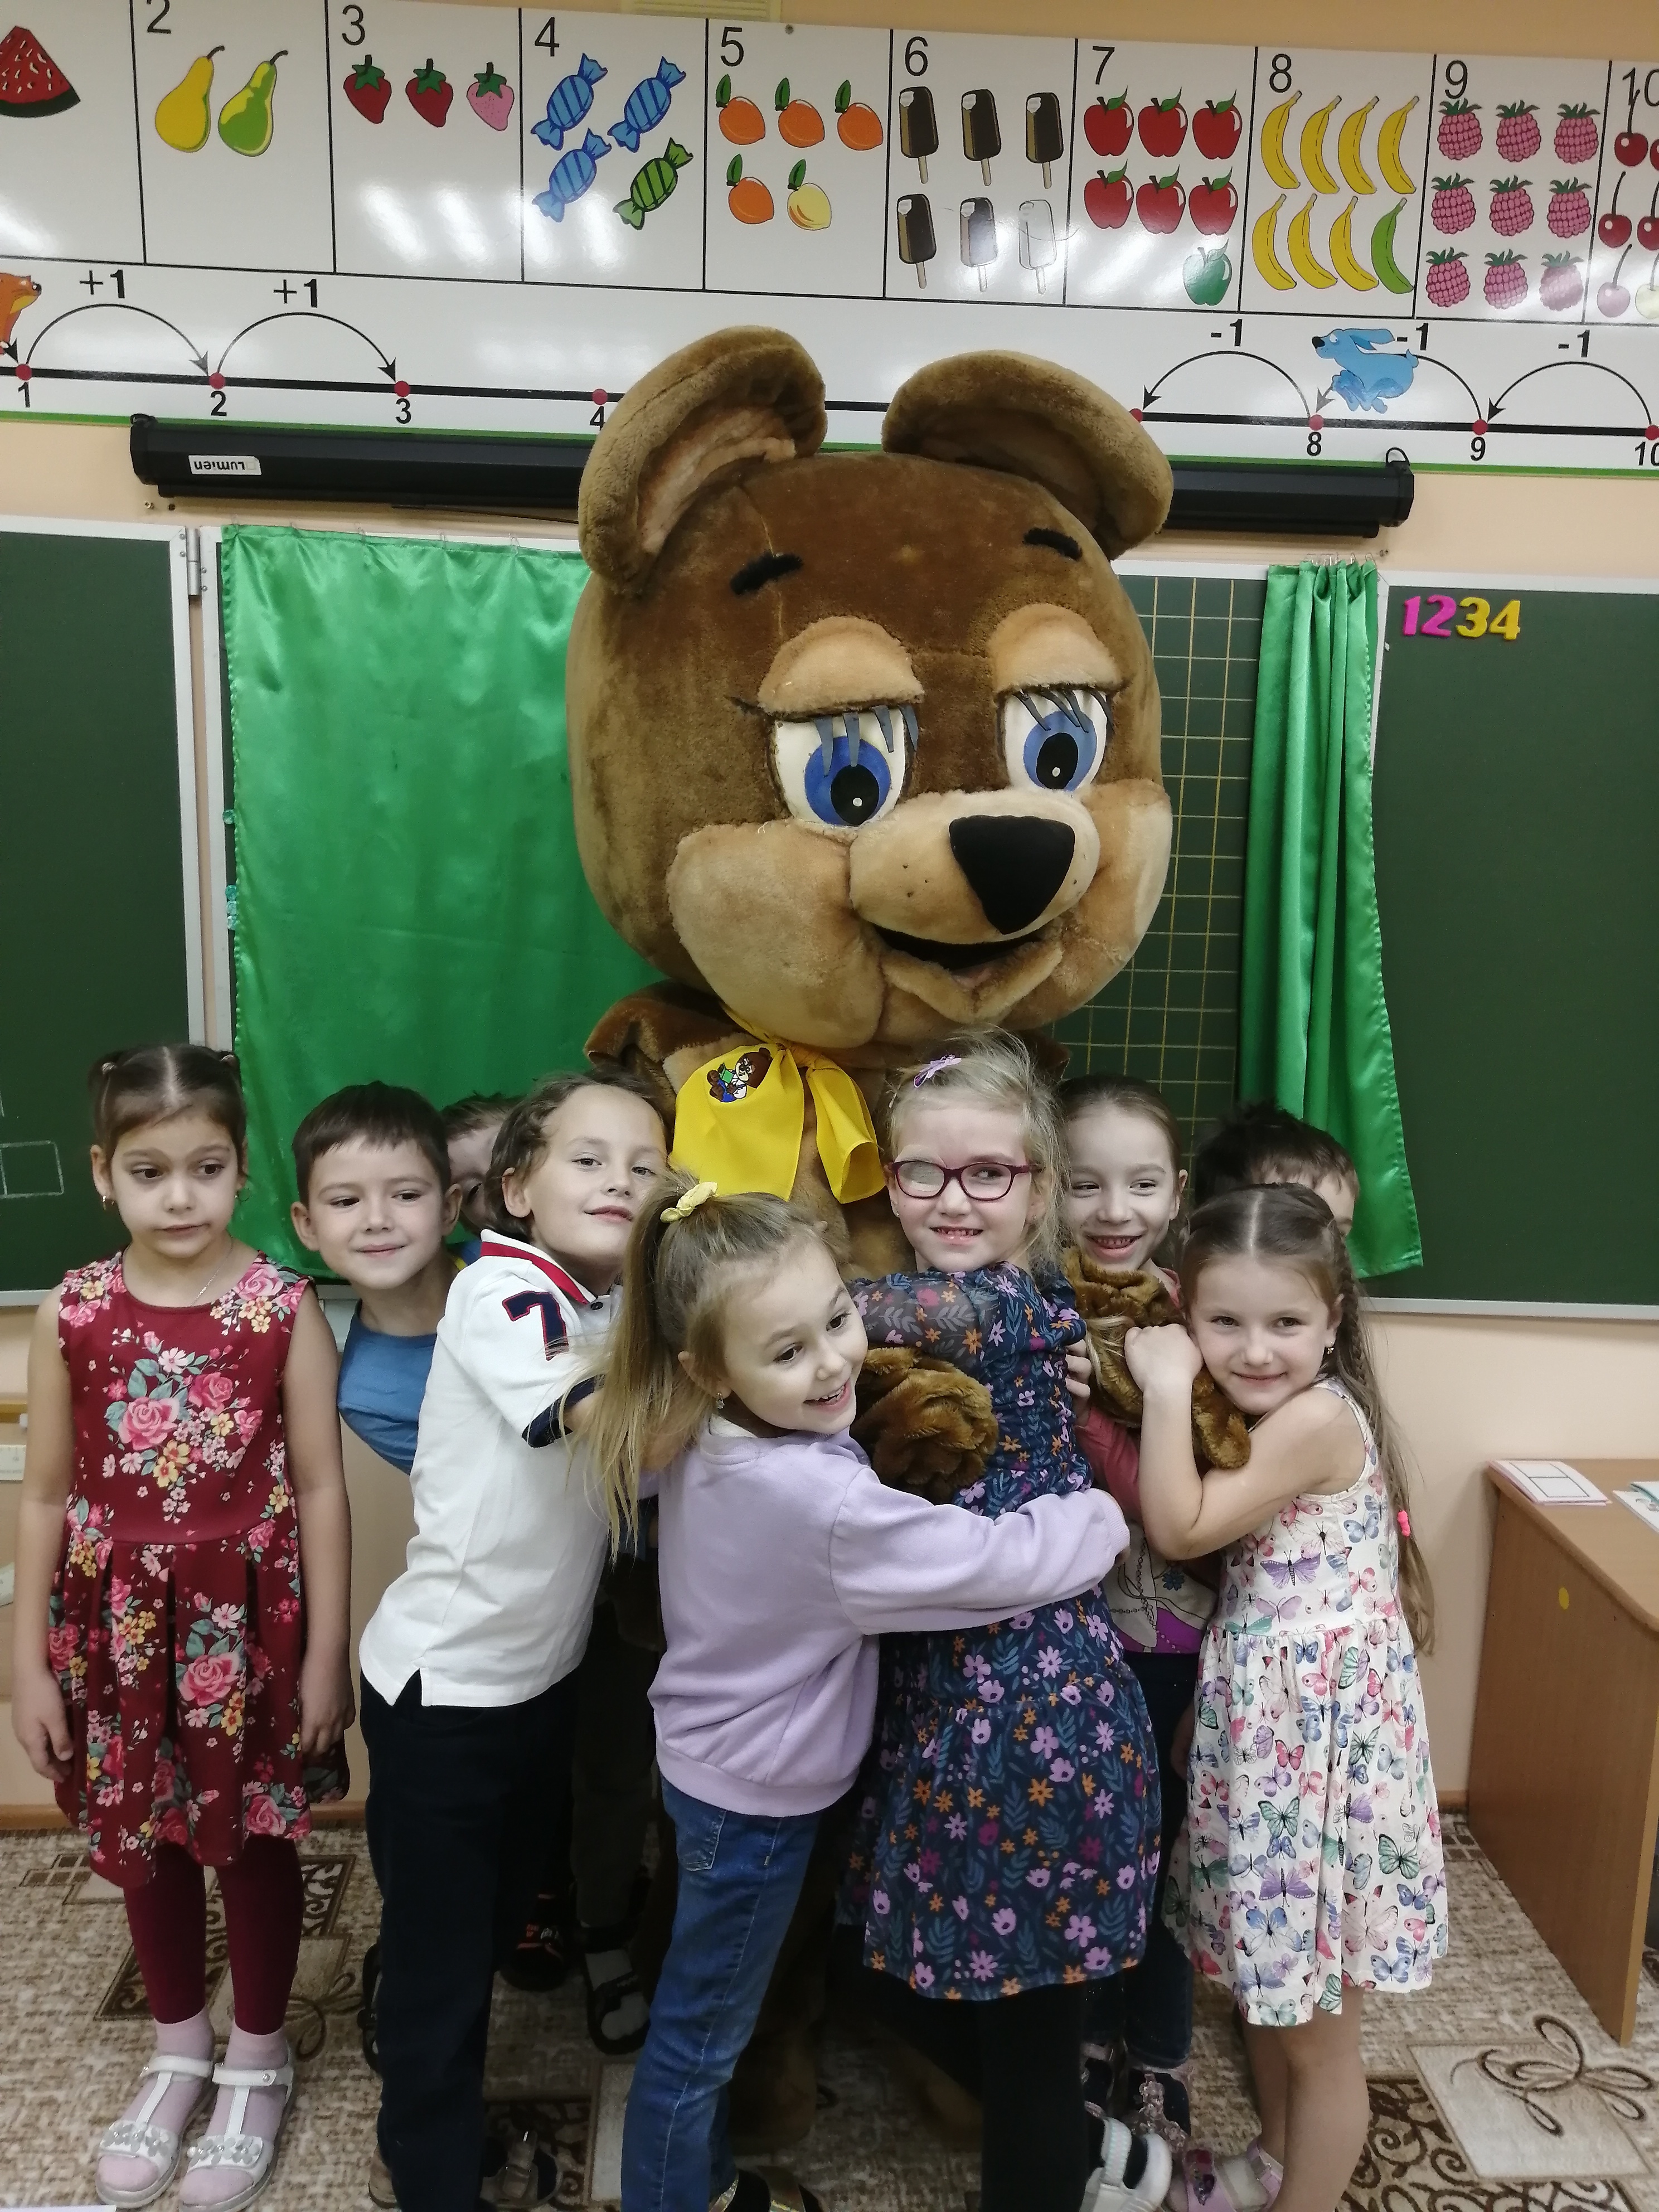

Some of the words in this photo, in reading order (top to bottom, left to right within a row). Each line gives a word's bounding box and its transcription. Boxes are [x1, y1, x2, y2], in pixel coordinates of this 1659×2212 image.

[147, 0, 171, 34] 2
[342, 4, 365, 46] 3
[535, 17, 560, 56] 4
[721, 27, 744, 66] 5
[905, 36, 928, 76] 6
[1093, 46, 1115, 85] 7
[1269, 54, 1292, 93] 8
[1445, 60, 1468, 99] 9
[18, 383, 30, 408] 1
[211, 391, 227, 416] 2
[396, 398, 411, 424] 3
[590, 406, 605, 431] 4
[1307, 432, 1321, 456] 8
[1471, 437, 1485, 461] 9
[194, 461, 245, 470] Lumien
[1403, 594, 1521, 640] 1234
[502, 1291, 569, 1361] 7
